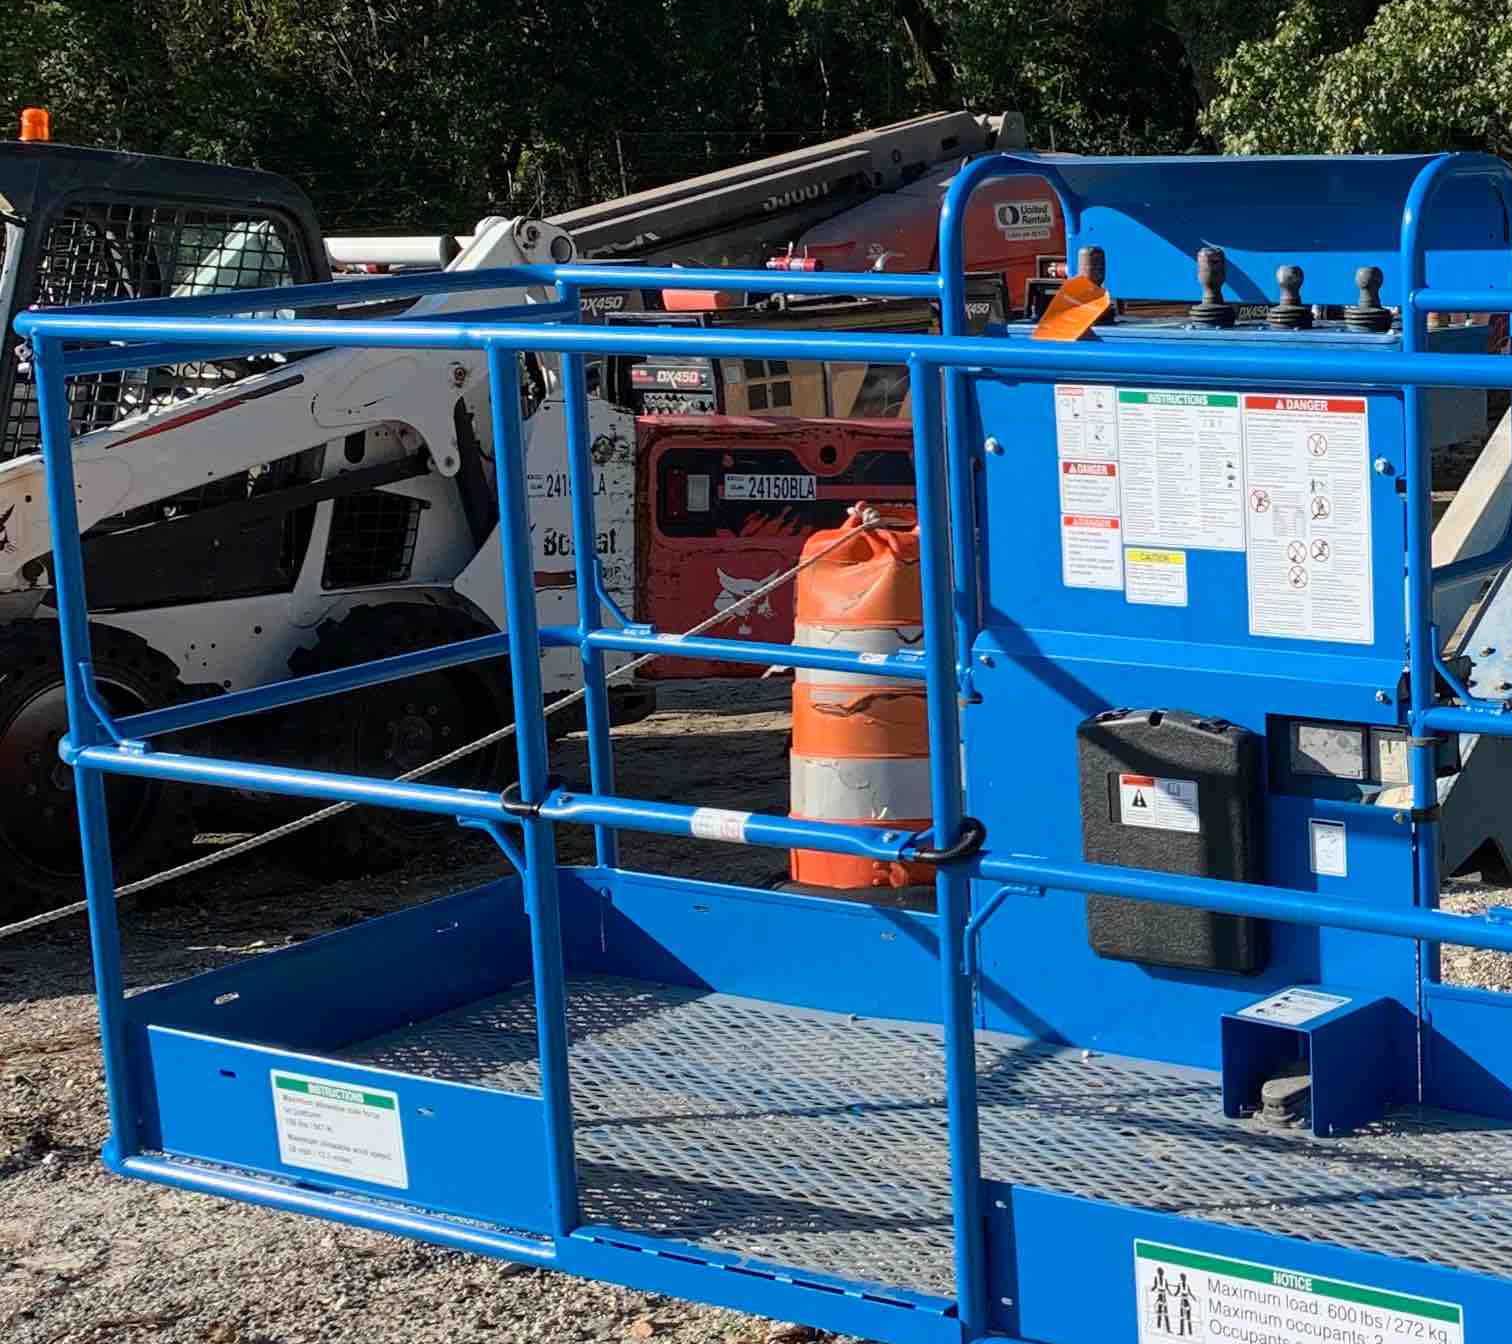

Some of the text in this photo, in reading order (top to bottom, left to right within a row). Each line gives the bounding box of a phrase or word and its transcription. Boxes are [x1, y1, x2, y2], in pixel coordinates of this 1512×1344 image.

[656, 369, 699, 389] DX450
[1285, 399, 1328, 411] DANGER
[748, 476, 816, 499] 24150BLA
[543, 527, 617, 556] Boat
[1272, 1271, 1312, 1291] NOTICE
[1208, 1277, 1281, 1306] Maximum
[1328, 1303, 1356, 1323] 600
[1360, 1311, 1383, 1329] lbs
[1386, 1316, 1391, 1332] /
[1394, 1317, 1424, 1338] 272
[1209, 1297, 1282, 1328] Maximum
